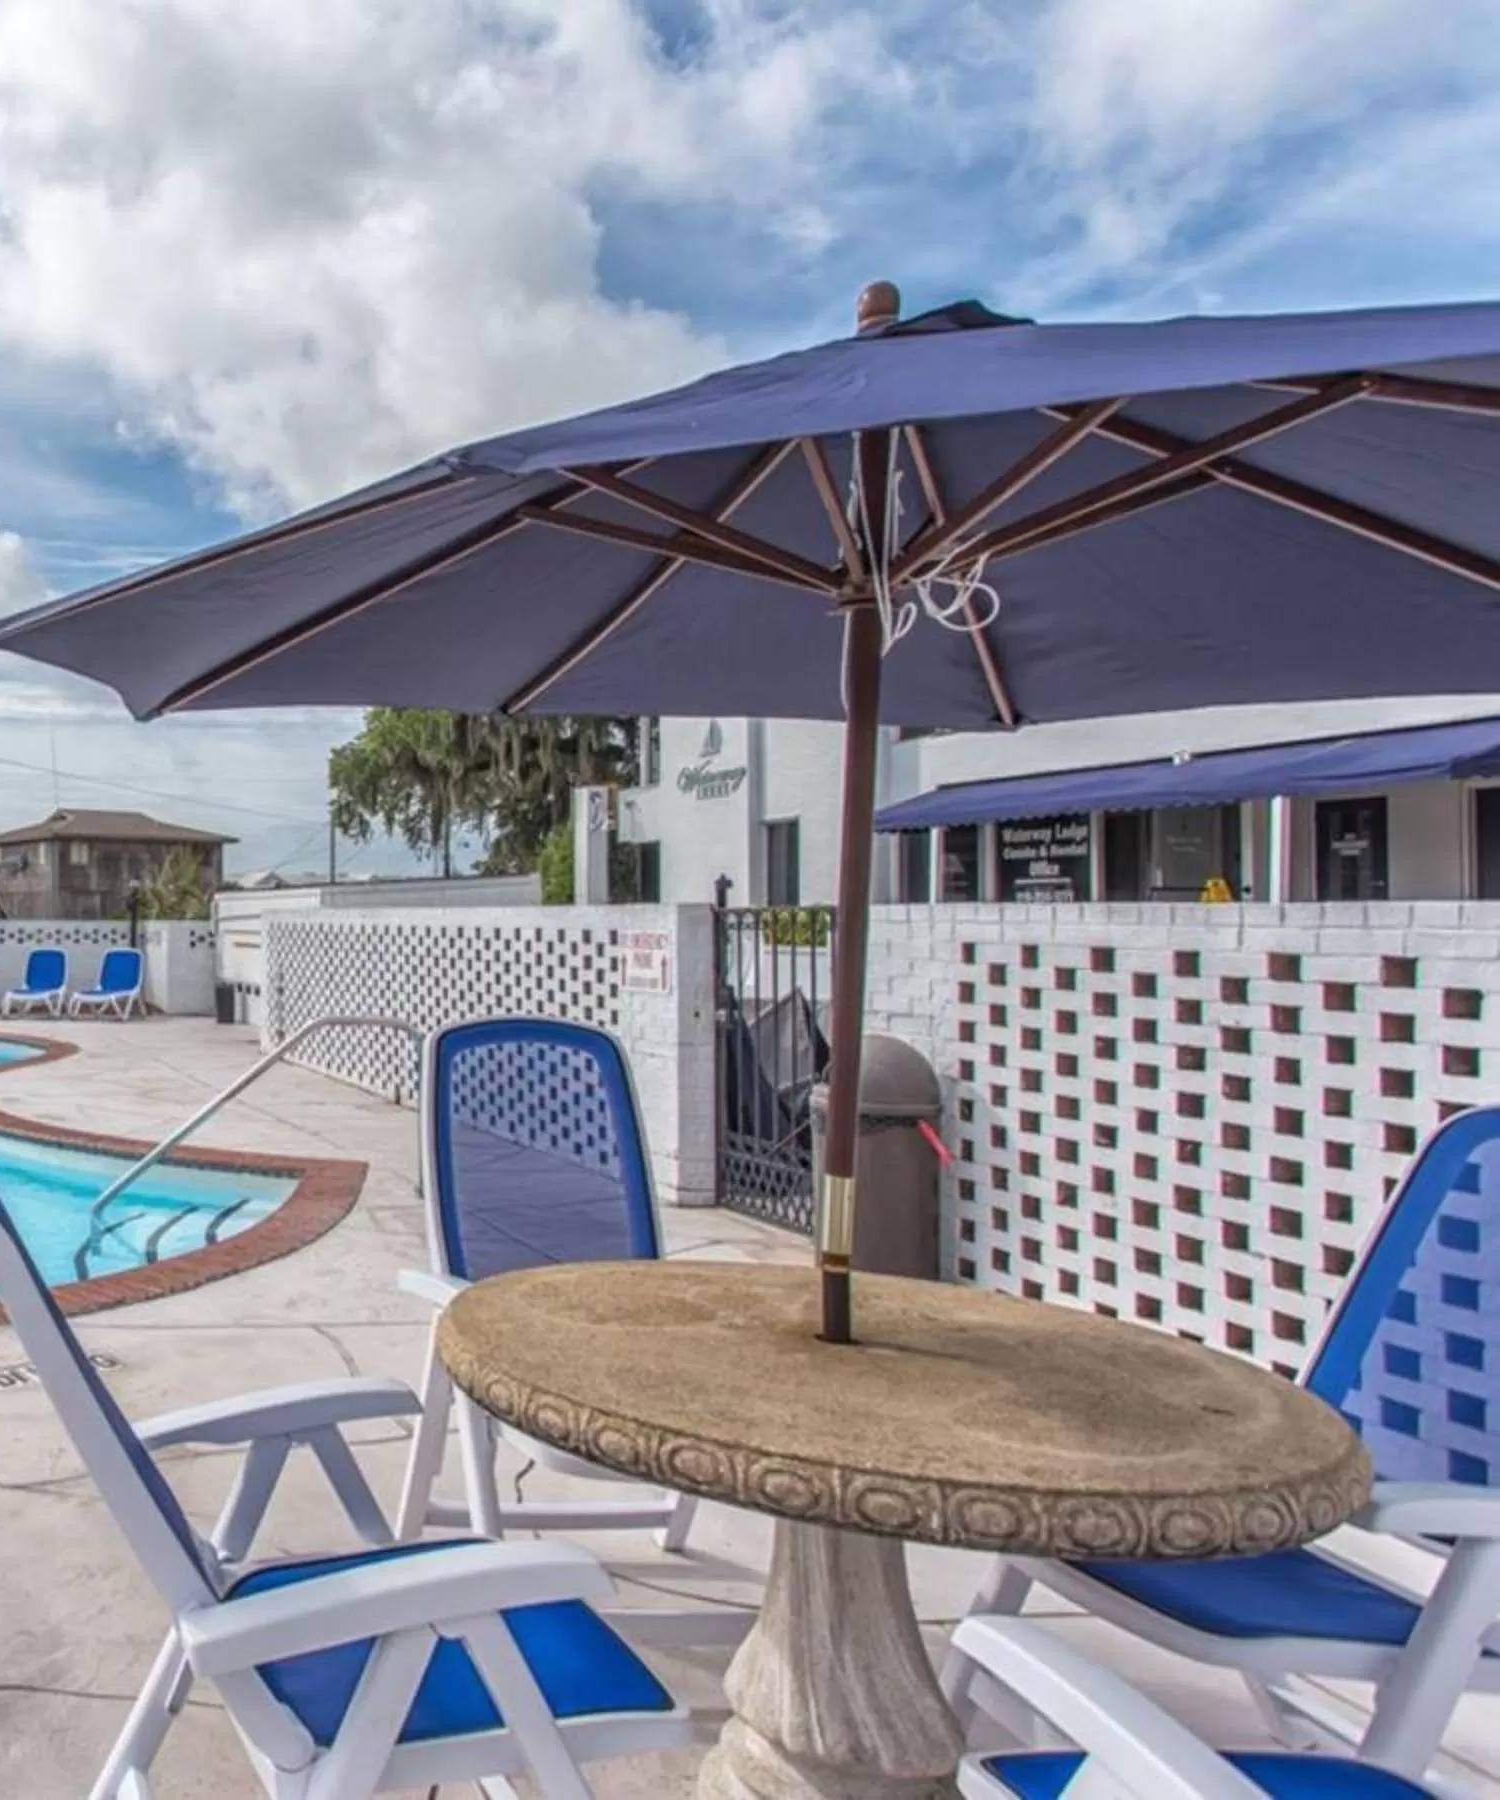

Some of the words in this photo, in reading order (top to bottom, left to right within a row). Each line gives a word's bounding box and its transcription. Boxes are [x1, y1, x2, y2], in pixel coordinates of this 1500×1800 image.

[1001, 827, 1052, 845] Waterway
[1054, 822, 1088, 842] Lodge
[1028, 860, 1059, 876] Office
